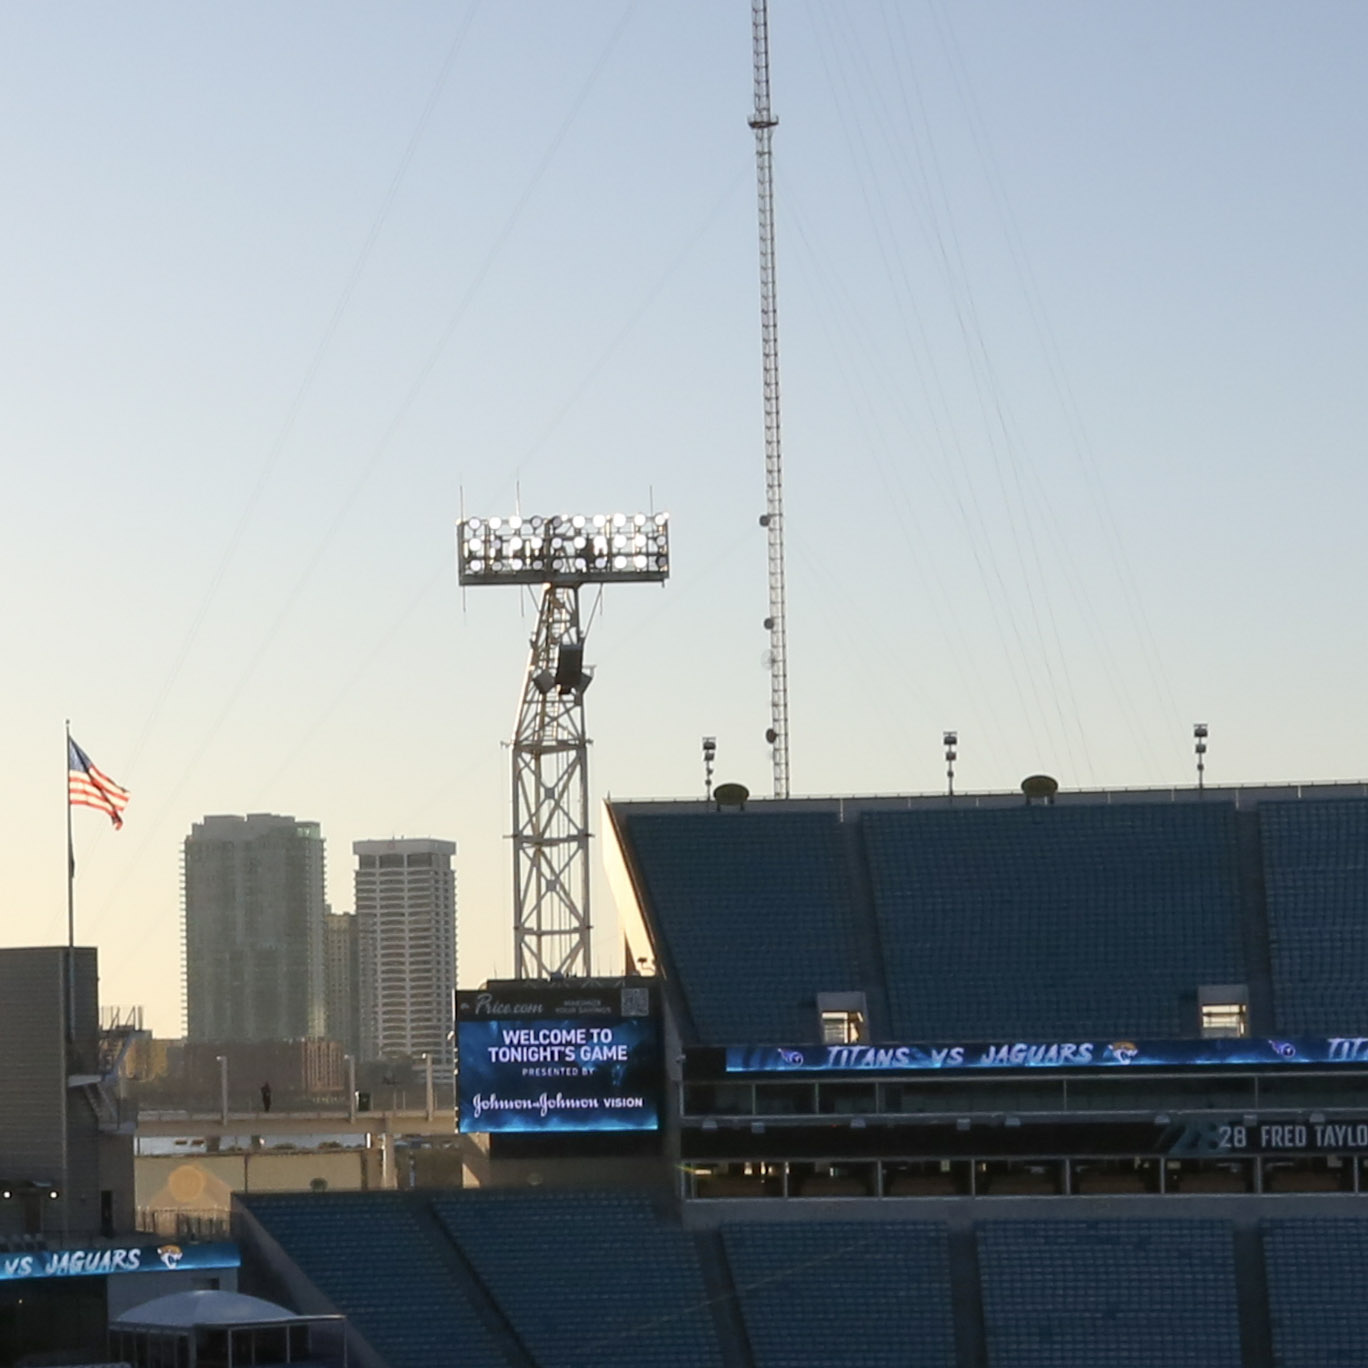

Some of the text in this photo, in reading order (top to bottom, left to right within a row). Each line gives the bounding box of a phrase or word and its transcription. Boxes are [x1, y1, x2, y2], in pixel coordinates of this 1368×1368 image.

[475, 993, 544, 1015] Price.com
[502, 1029, 612, 1045] WELCOME TO
[488, 1046, 627, 1063] TONIGHT'S GAME
[827, 1043, 1093, 1068] TITANS VS JAGUARS
[522, 1067, 595, 1077] PRESENTED BY
[604, 1098, 643, 1108] VISION
[1218, 1126, 1246, 1148] 28
[1261, 1125, 1307, 1148] FRED
[5, 1254, 32, 1276] VS
[45, 1249, 141, 1276] JAGUARS
